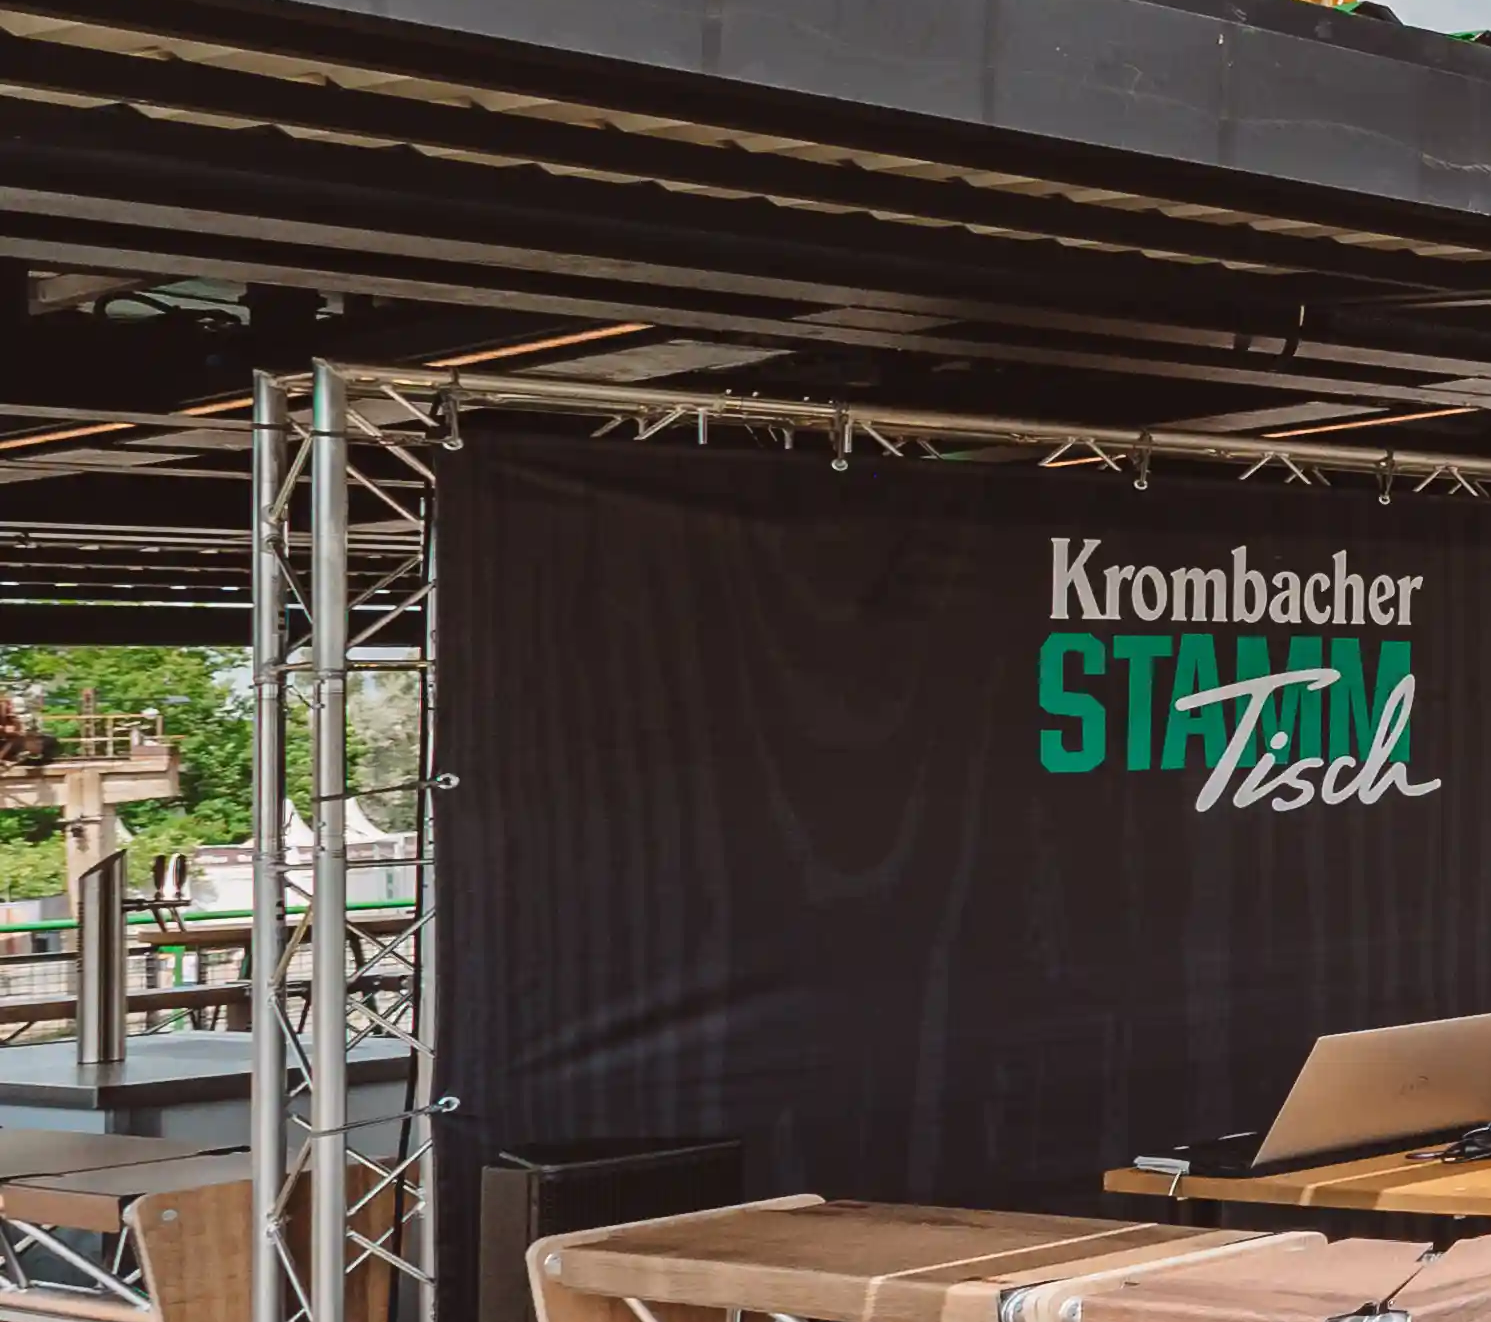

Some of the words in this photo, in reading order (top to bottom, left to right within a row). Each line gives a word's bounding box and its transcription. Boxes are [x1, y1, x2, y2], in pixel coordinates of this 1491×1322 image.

[1049, 537, 1424, 626] Krombacher
[1039, 632, 1412, 774] STAMM
[1175, 668, 1442, 812] Tisch
